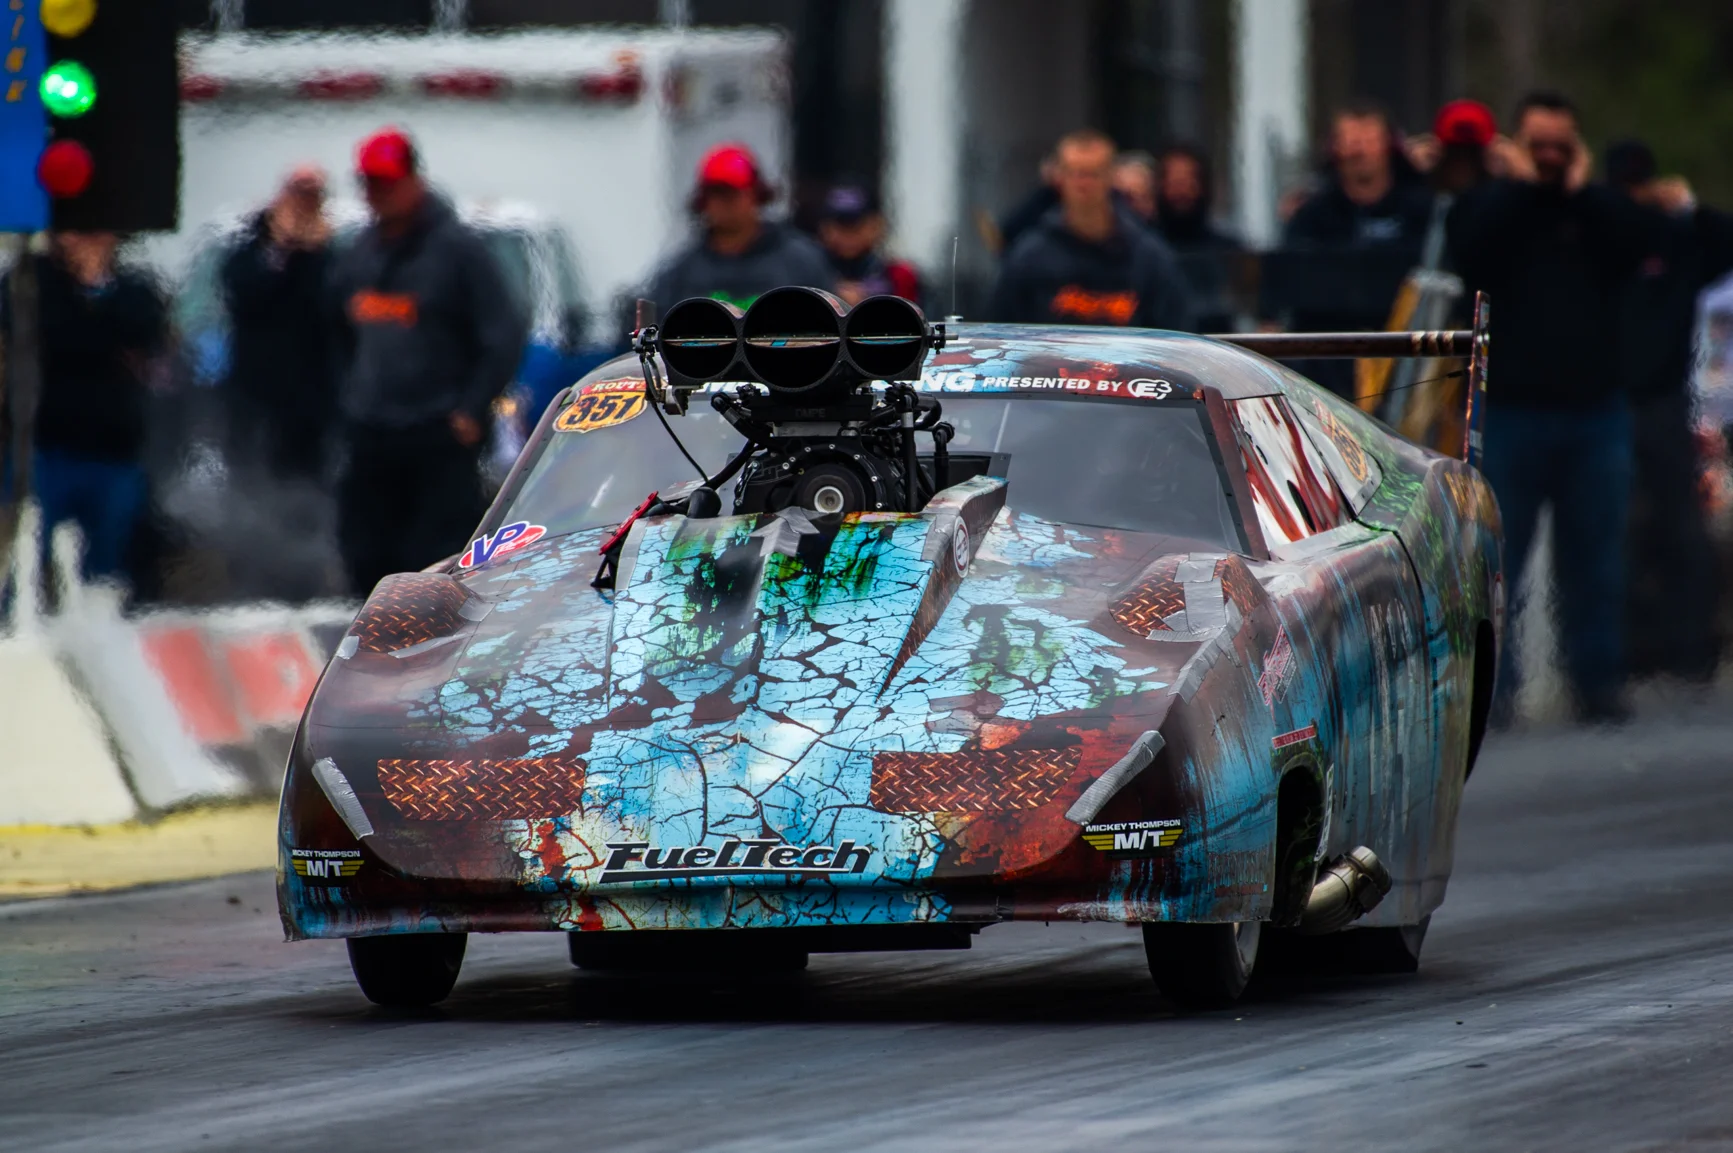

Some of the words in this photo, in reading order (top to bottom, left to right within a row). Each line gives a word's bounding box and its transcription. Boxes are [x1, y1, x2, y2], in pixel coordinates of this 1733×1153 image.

[914, 371, 976, 392] NG
[983, 377, 1090, 390] PRESENTED
[1097, 381, 1122, 392] BY
[566, 395, 642, 425] 351
[472, 521, 530, 567] VP
[1085, 823, 1127, 832] MICKEY
[1128, 819, 1181, 830] THOMPSON
[1114, 830, 1165, 850] M/T
[314, 850, 360, 858] THOMPSON
[604, 839, 872, 874] FuelTech
[306, 859, 343, 878] M/T
